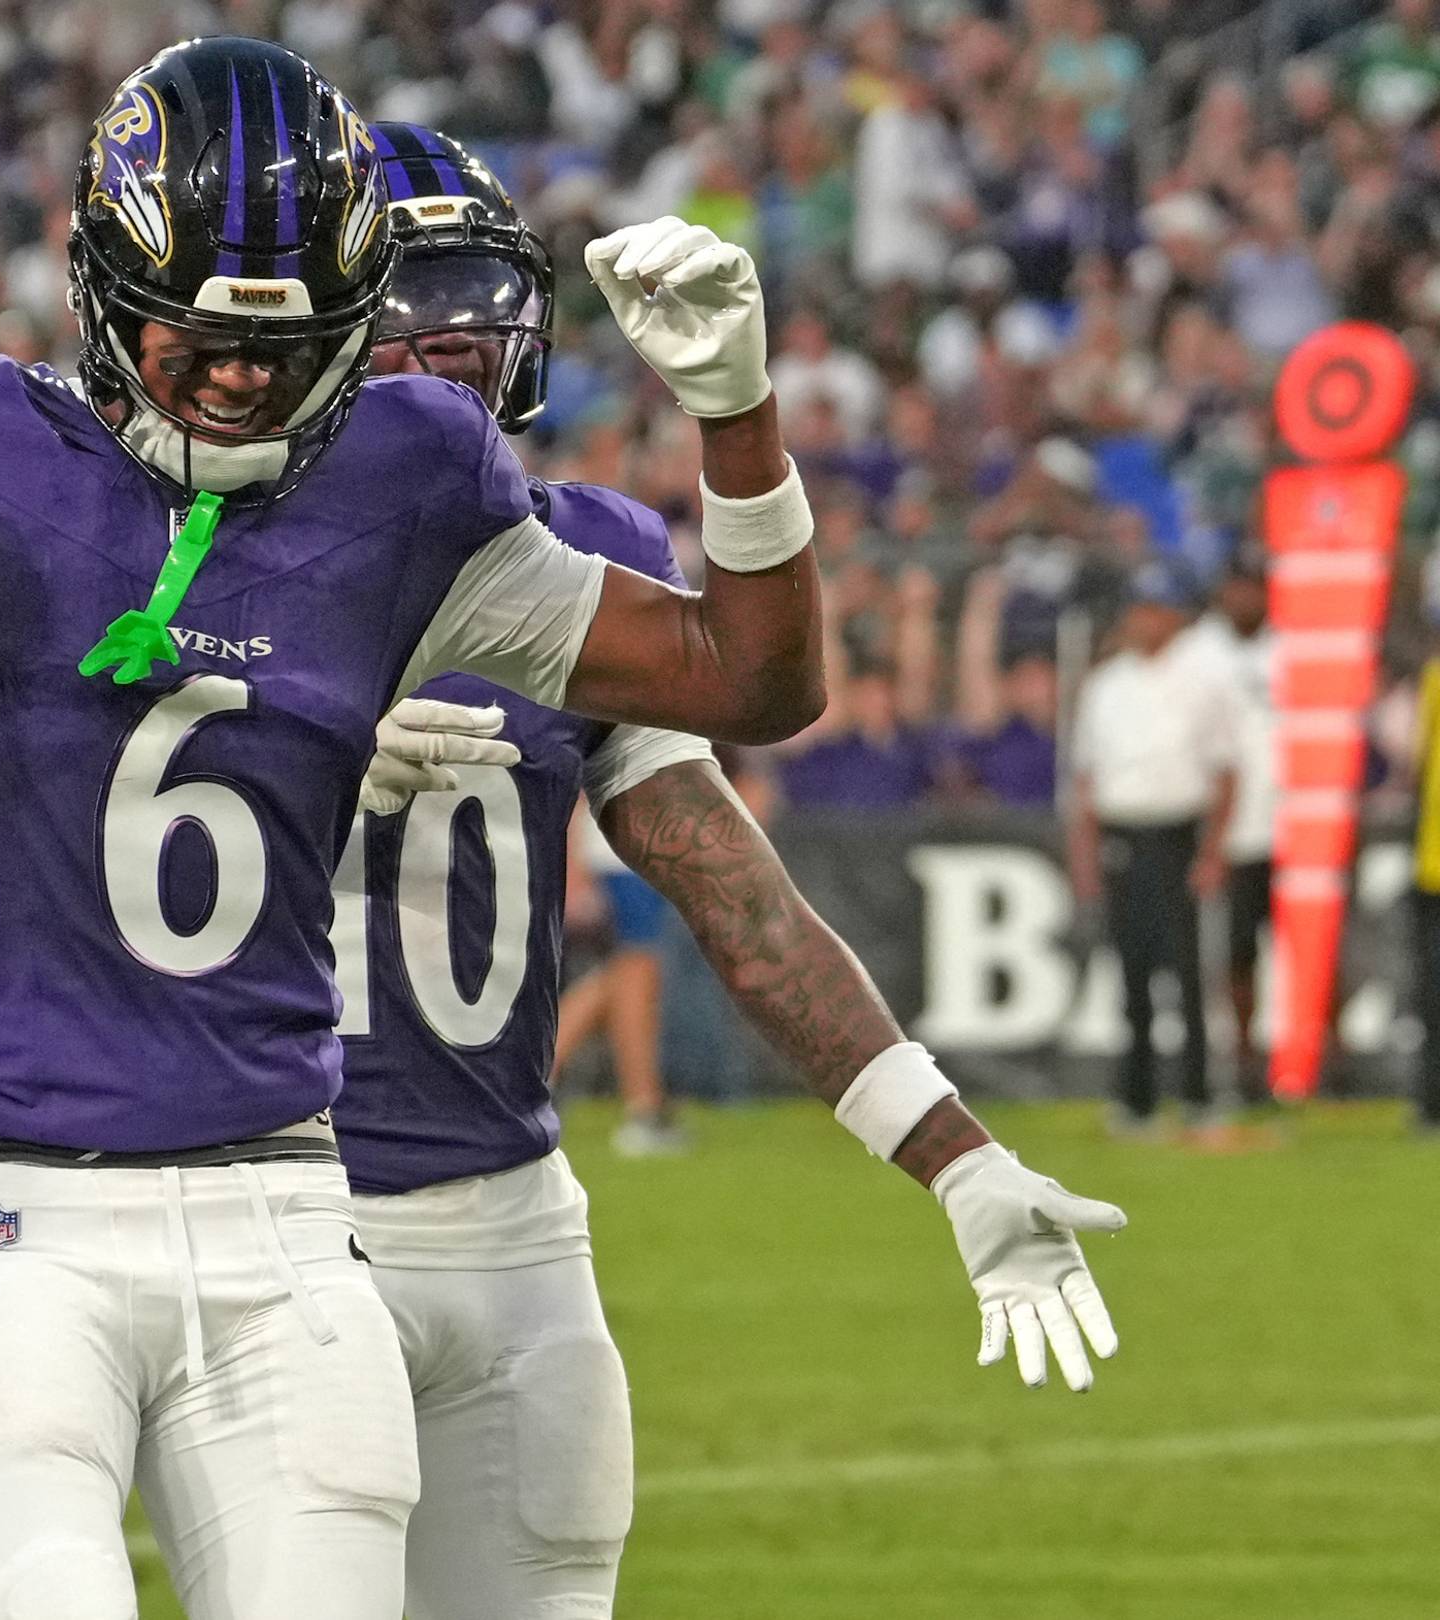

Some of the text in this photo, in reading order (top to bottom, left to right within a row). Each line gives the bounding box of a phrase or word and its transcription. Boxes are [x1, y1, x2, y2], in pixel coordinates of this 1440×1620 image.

[228, 286, 287, 306] RAVENS
[166, 626, 273, 663] VENS
[98, 673, 267, 978] 6
